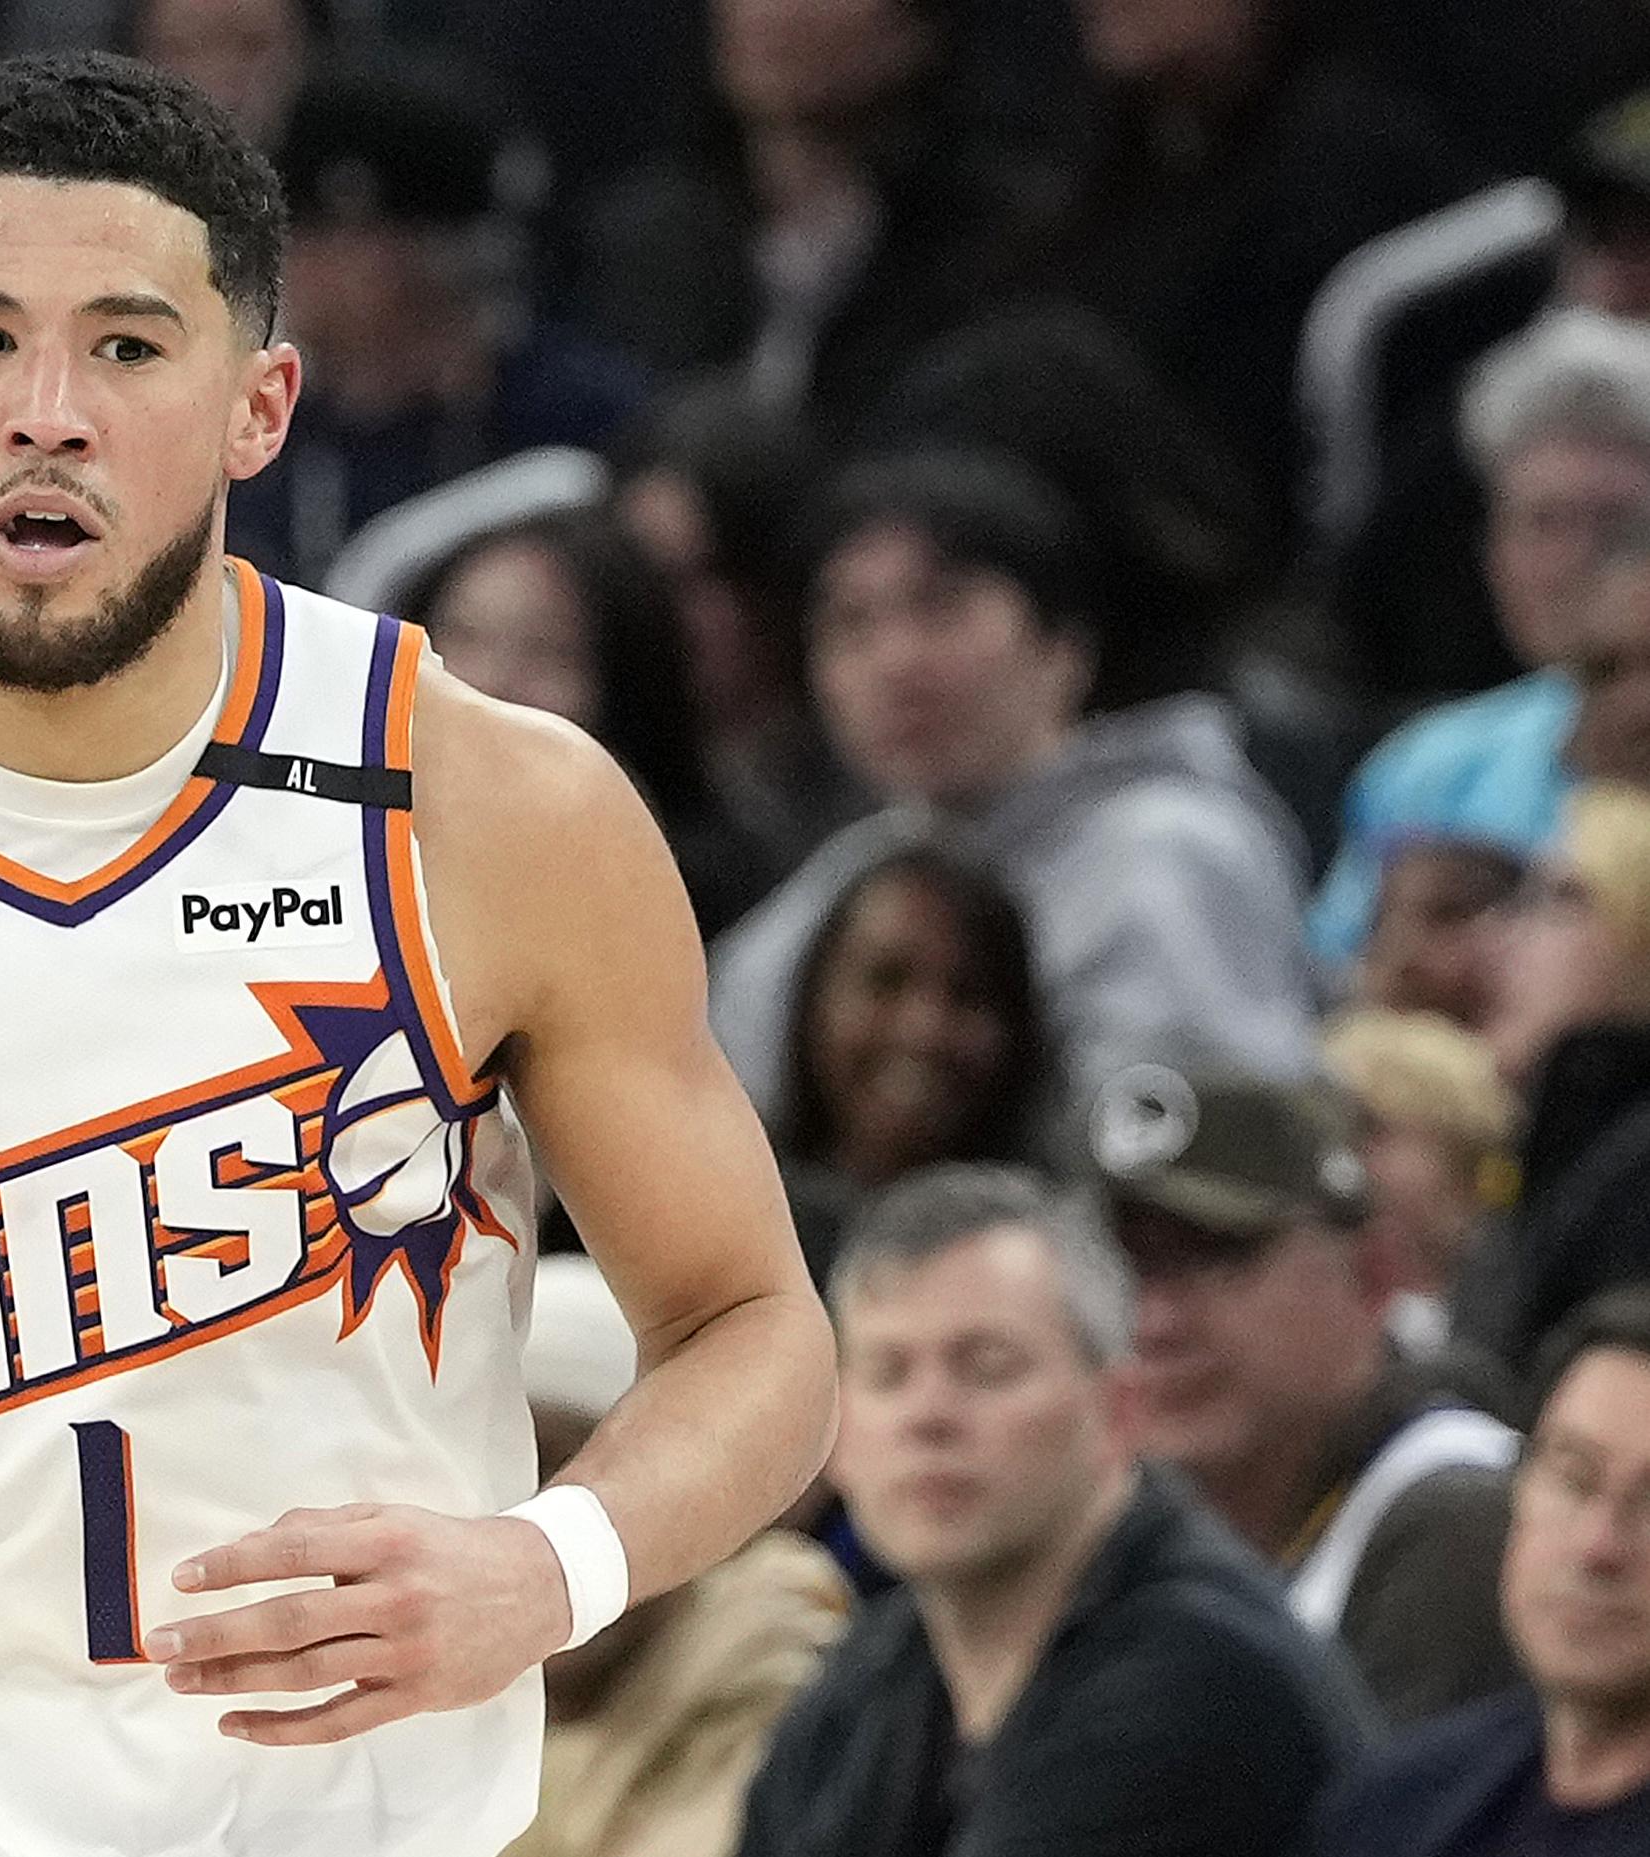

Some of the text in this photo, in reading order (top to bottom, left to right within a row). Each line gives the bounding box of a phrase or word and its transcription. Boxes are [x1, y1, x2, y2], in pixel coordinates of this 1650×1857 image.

[286, 760, 317, 792] AL
[181, 885, 343, 942] PayPal
[68, 1420, 146, 1665] 1
